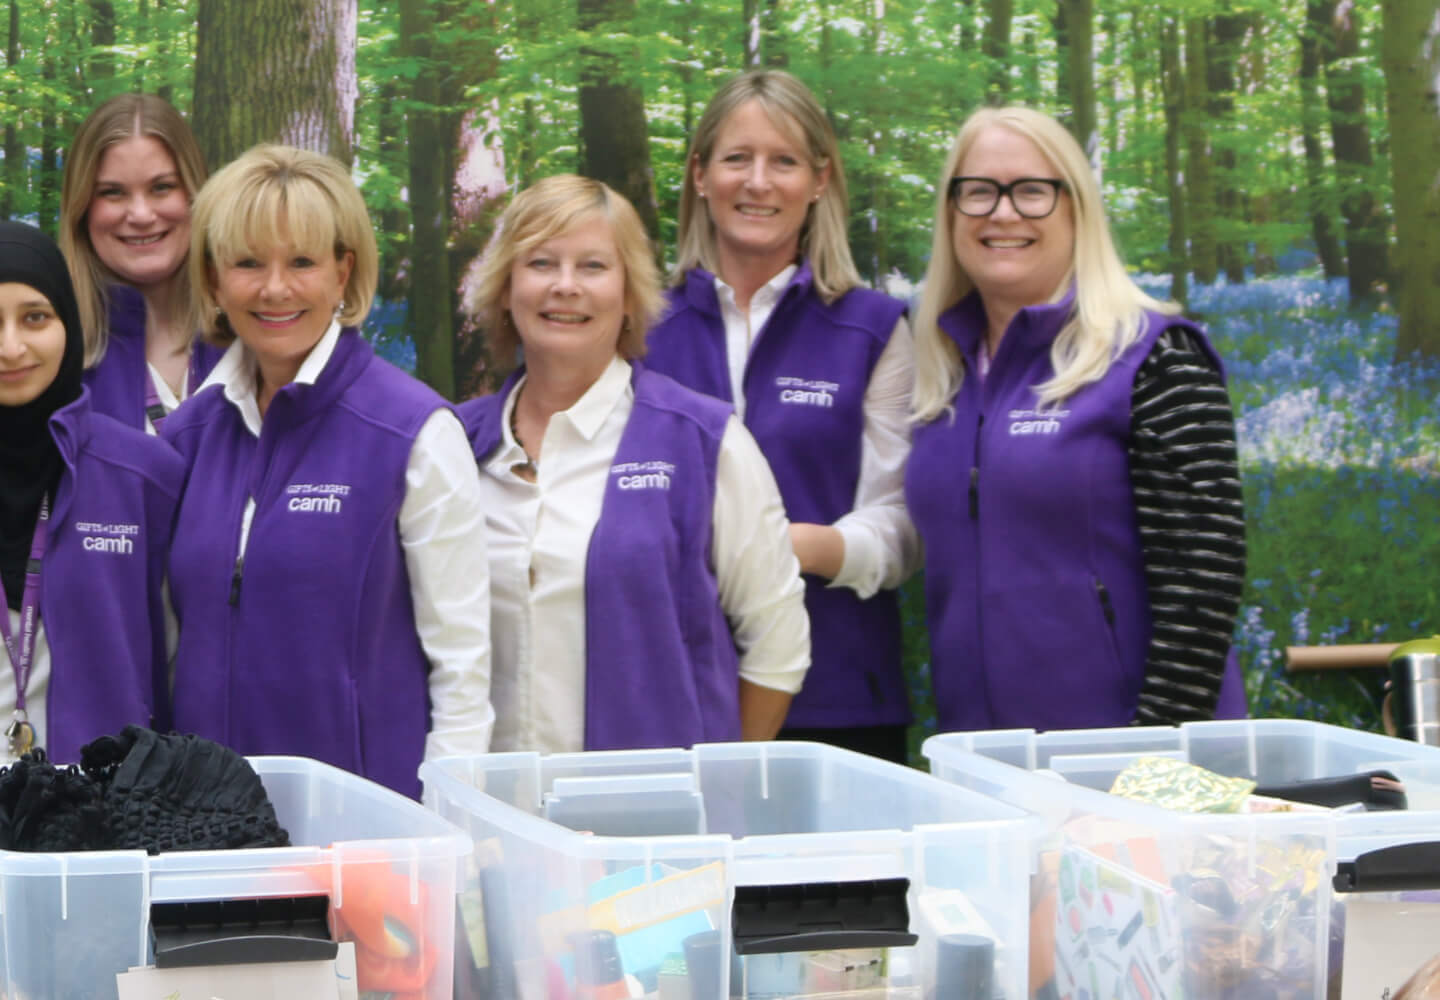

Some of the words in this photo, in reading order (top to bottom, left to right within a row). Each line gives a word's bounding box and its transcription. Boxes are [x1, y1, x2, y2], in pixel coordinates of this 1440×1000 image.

[780, 388, 833, 408] camh
[1009, 416, 1060, 436] camh
[319, 483, 351, 496] LIGHT
[618, 470, 670, 490] camh
[288, 493, 342, 514] camh
[108, 524, 139, 535] LIGHT
[83, 533, 133, 555] camh
